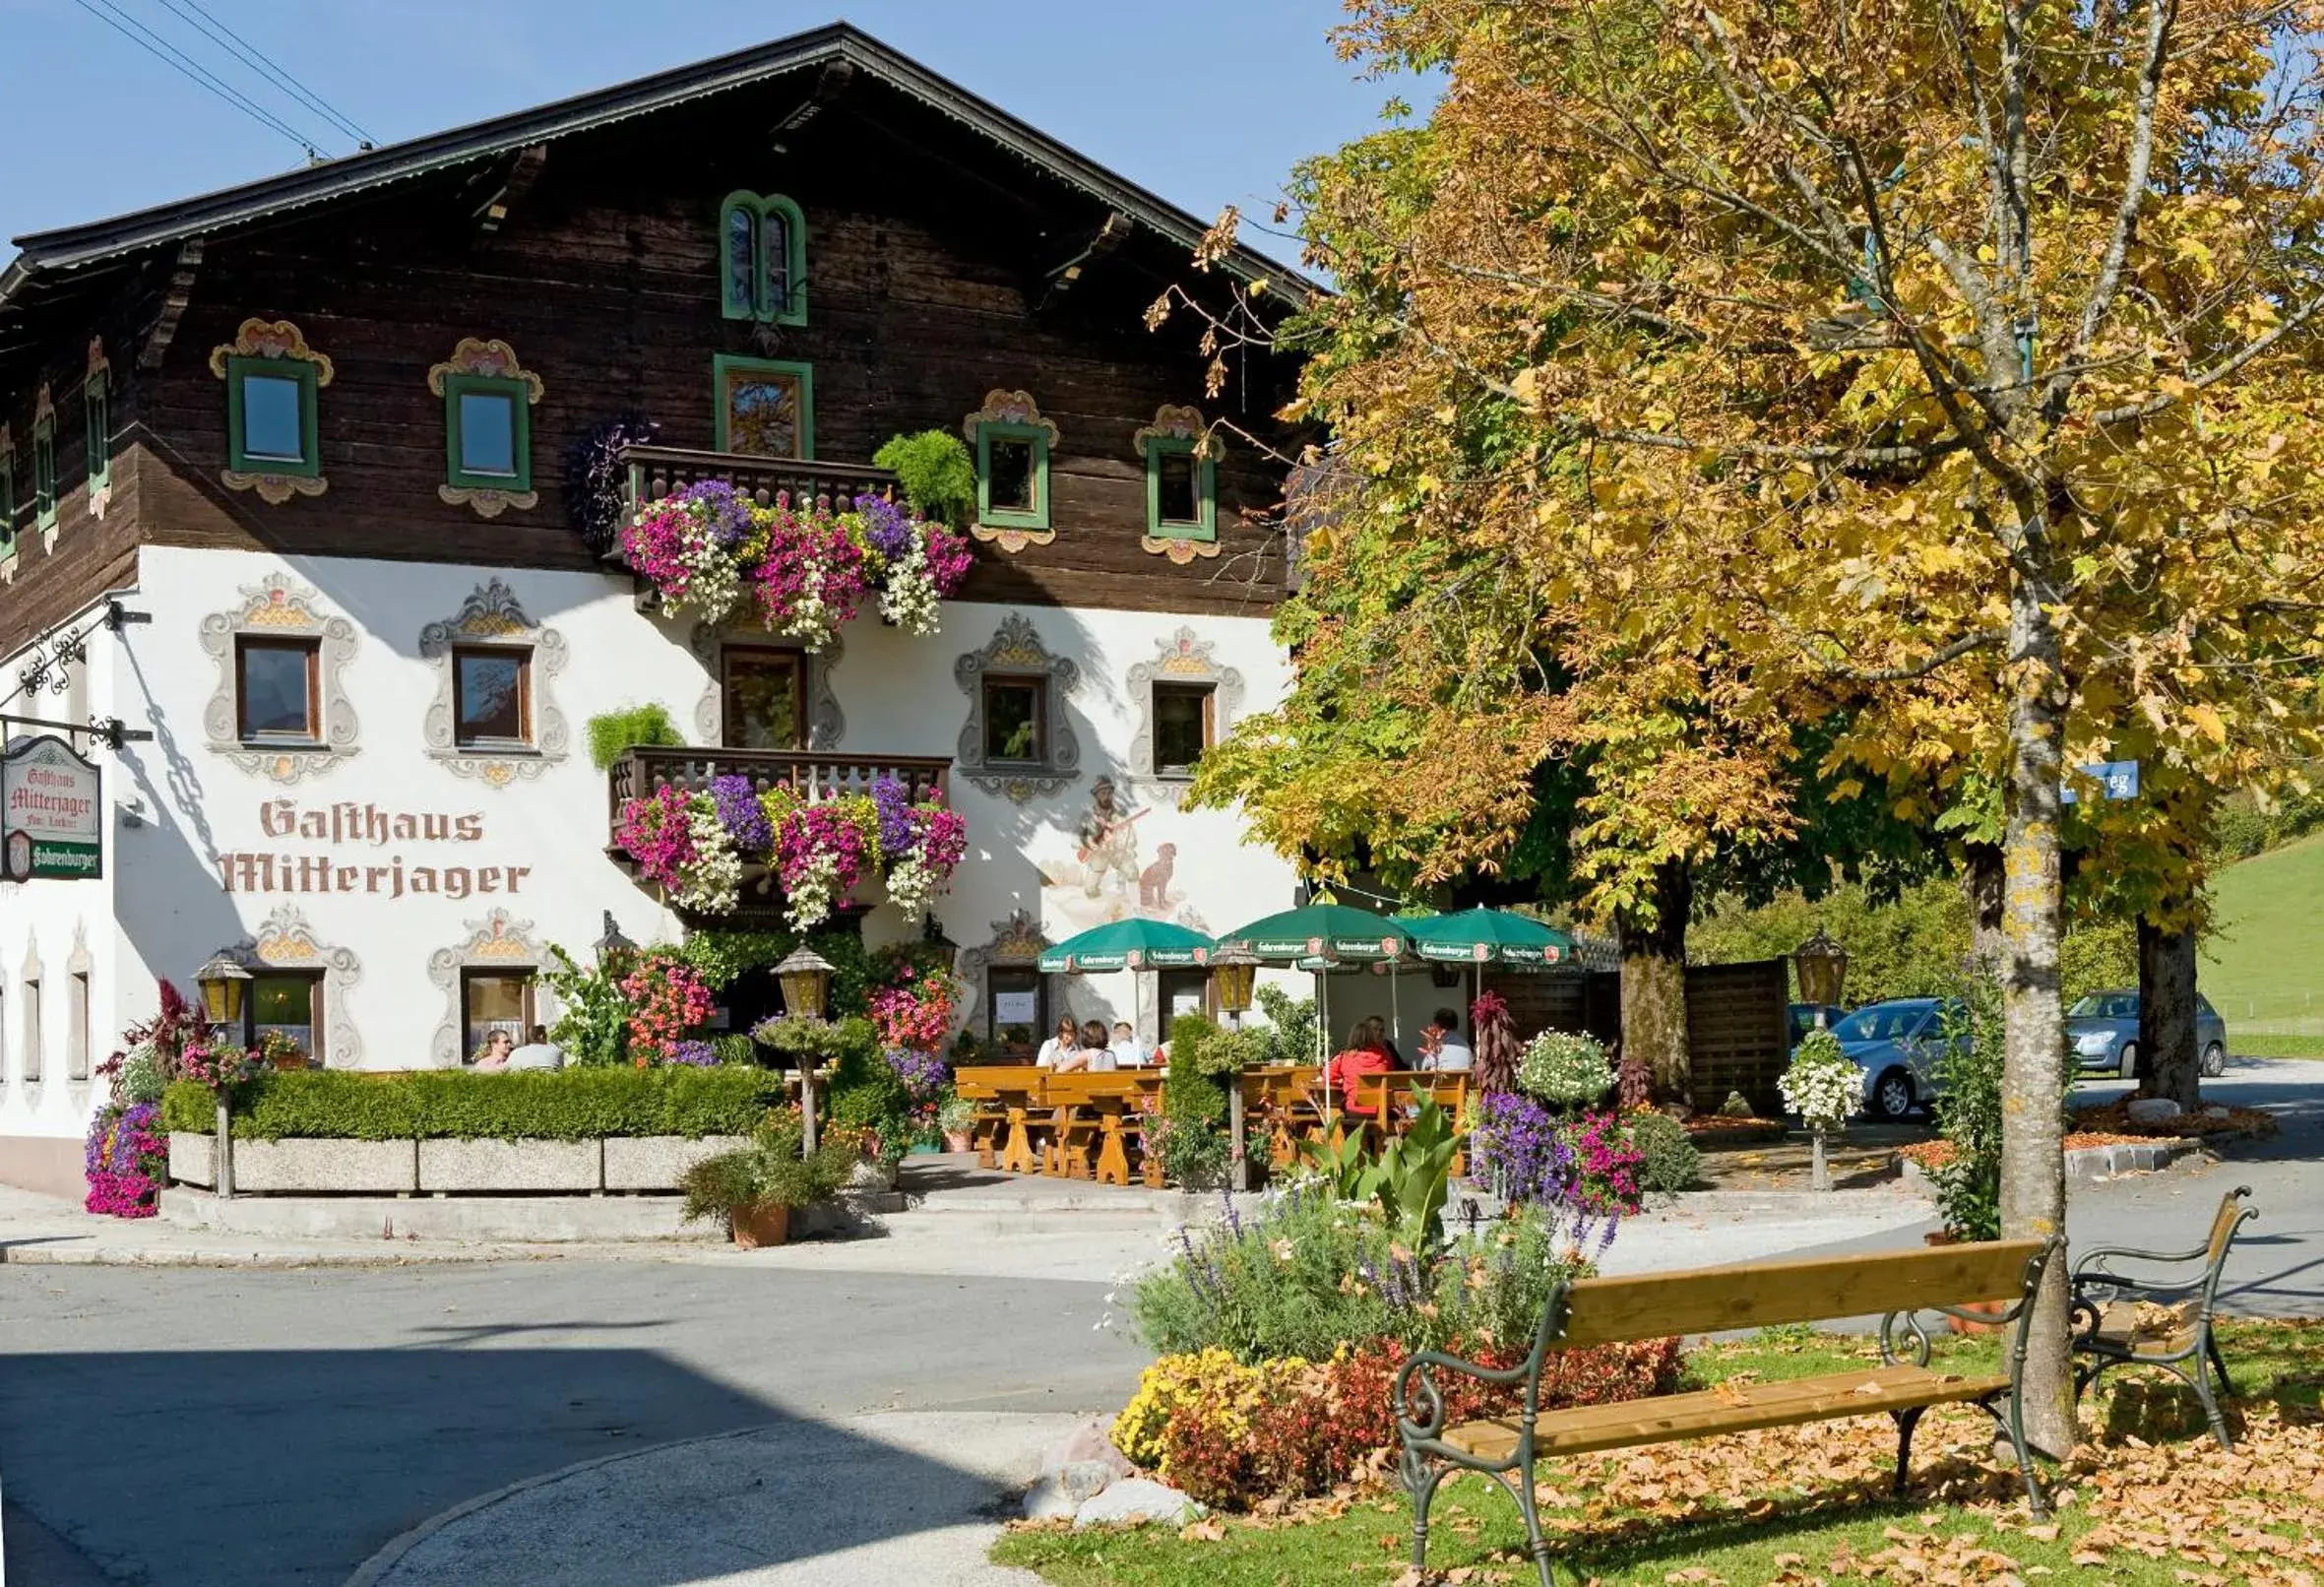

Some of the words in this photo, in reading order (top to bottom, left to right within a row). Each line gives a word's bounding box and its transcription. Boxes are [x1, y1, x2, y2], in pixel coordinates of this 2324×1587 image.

[28, 768, 76, 789] Gasthaus
[10, 787, 92, 816] Mitterjager
[259, 795, 486, 847] Gasthaus
[218, 853, 533, 900] Mitterjager
